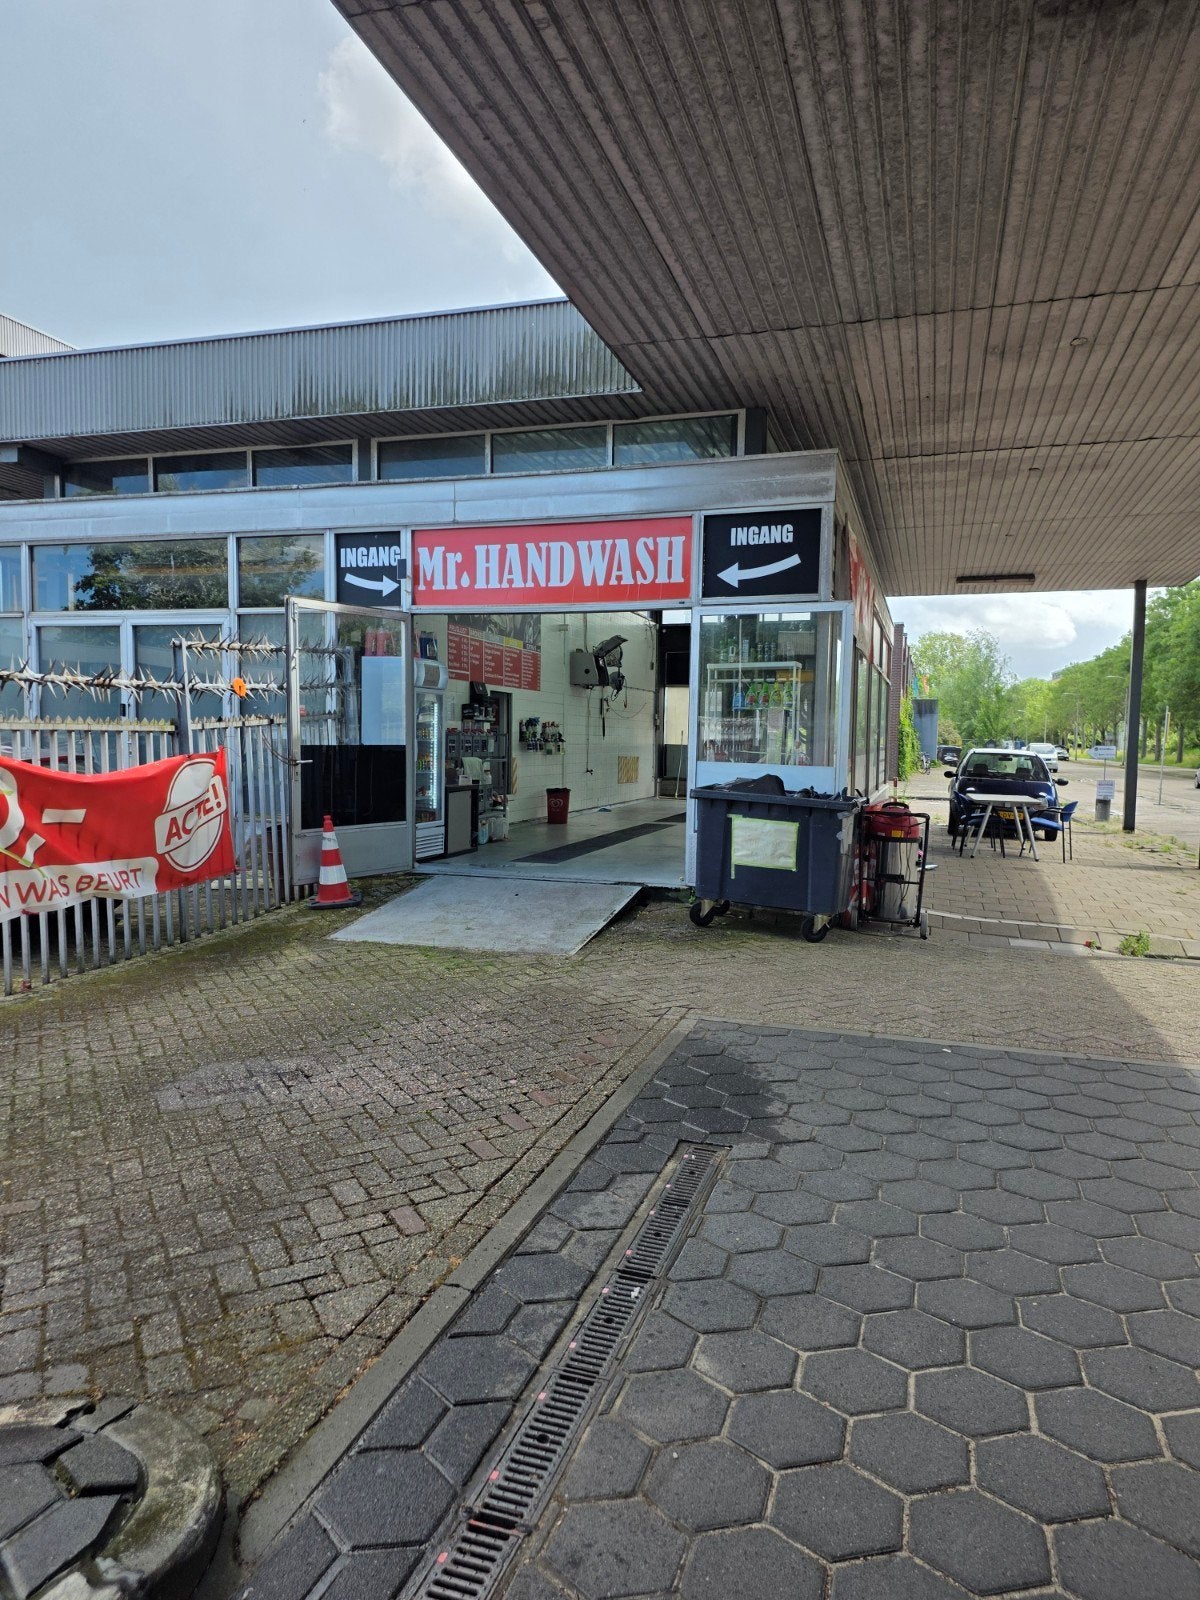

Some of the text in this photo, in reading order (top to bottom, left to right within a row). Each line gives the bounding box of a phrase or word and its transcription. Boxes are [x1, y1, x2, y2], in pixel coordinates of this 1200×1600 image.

[730, 524, 794, 546] INGANG
[340, 545, 401, 568] INGANG
[417, 535, 685, 591] Mr. HANDWASH
